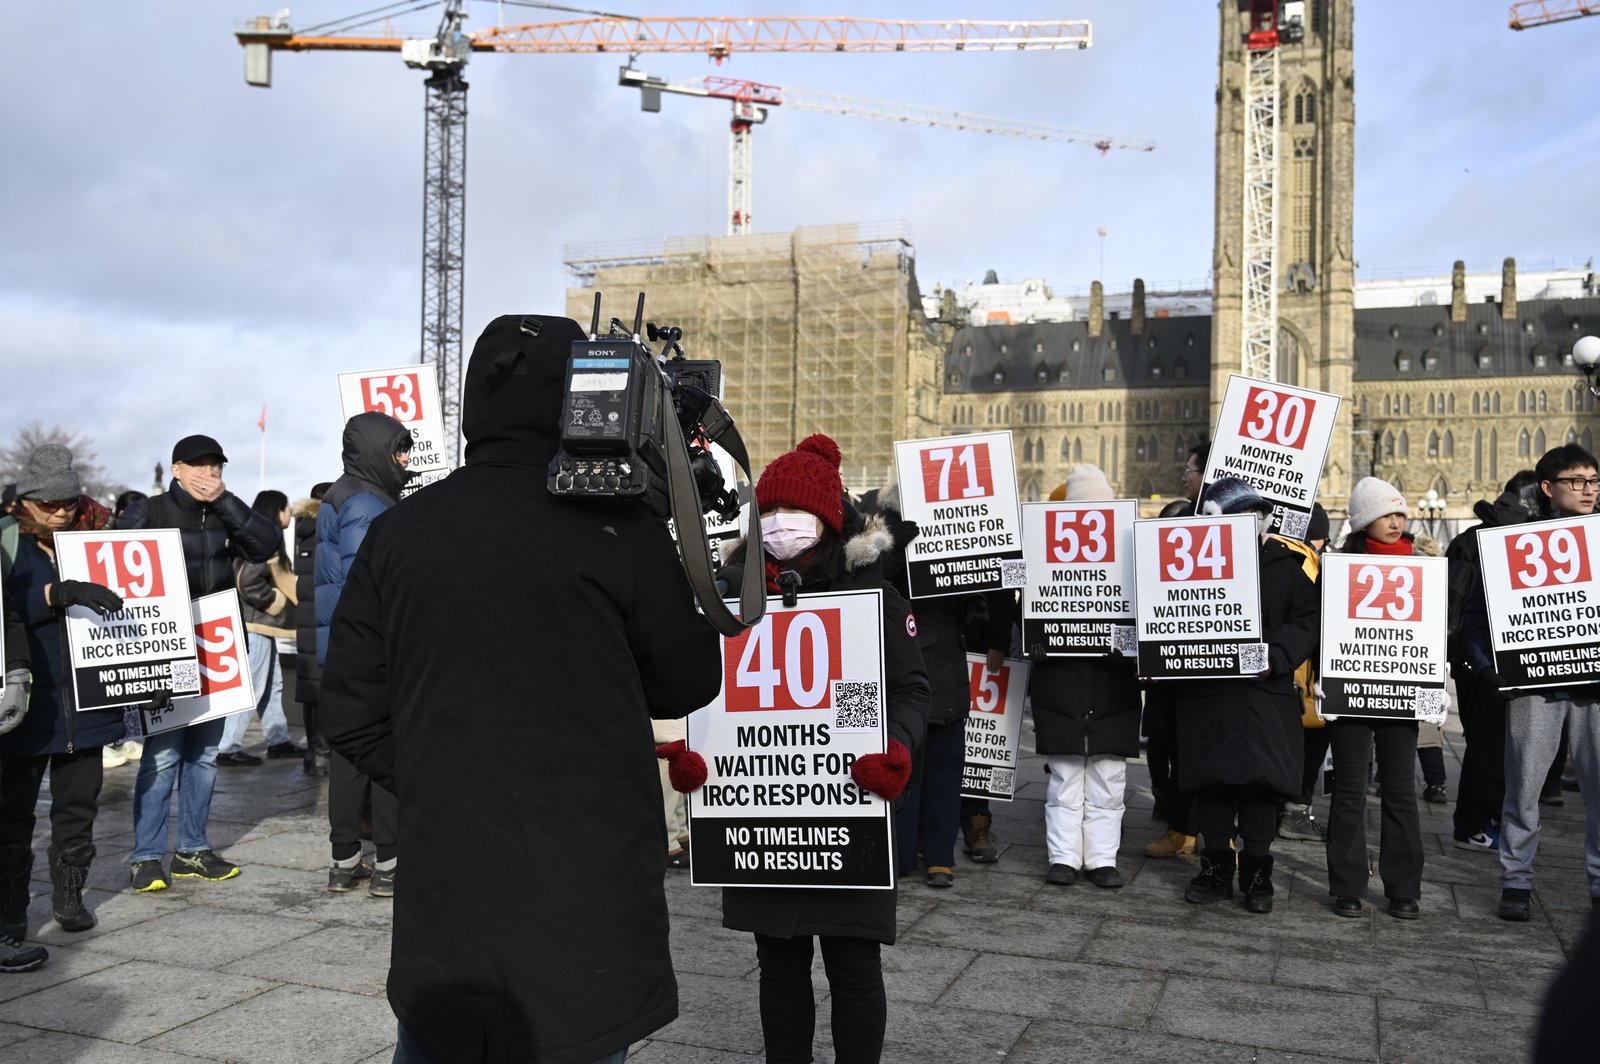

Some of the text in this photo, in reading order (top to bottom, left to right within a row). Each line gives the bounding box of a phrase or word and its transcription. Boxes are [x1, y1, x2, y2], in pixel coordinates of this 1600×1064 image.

[369, 374, 417, 422] 53
[1247, 390, 1306, 446] 30
[412, 440, 433, 452] FOR
[1240, 444, 1293, 466] MONTHS
[929, 445, 985, 500] 71
[1224, 455, 1303, 484] WAITING FOR
[933, 504, 989, 520] MONTHS
[921, 518, 1004, 537] WAITING FOR
[1053, 509, 1107, 562] 53
[915, 533, 1014, 554] IRCC RESPONSE
[1167, 525, 1226, 580] 34
[1515, 528, 1581, 587] 39
[96, 540, 153, 598] 19
[930, 557, 1002, 574] NO TIMELINES
[936, 570, 1000, 587] NO RESULTS
[1052, 569, 1107, 582] MONTHS
[1039, 584, 1122, 597] WAITING FOR
[1168, 587, 1226, 601] MONTHS
[1356, 565, 1414, 620] 23
[1522, 590, 1587, 608] MONTHS
[102, 605, 160, 621] MONTHS
[1031, 599, 1130, 613] IRCC RESPONSE
[1153, 603, 1242, 618] WAITING FOR
[1508, 609, 1572, 626] WAITING
[88, 621, 177, 640] WAITING FOR
[1044, 623, 1059, 634] NO
[1145, 619, 1252, 635] IRCC RESPONSE
[1355, 627, 1413, 641] MONTHS
[1501, 622, 1600, 643] IRCC RESPON
[82, 637, 187, 659] IRCC RESPONSE
[1049, 636, 1112, 647] NO RESULTS
[1160, 643, 1239, 656] NO TIMELINES
[1340, 643, 1428, 658] WAITING FOR
[1519, 652, 1537, 664] NO
[736, 612, 829, 708] 40
[1165, 657, 1234, 669] NO RESULTS
[1331, 659, 1436, 675] IRCC RESPONSE
[1527, 660, 1600, 677] NO RESULTS
[99, 664, 171, 683] NO TIMELINE
[106, 678, 172, 697] NO RESULTS
[1344, 683, 1417, 696] NO TIMELINE
[1349, 697, 1416, 710] NO RESULTS
[964, 717, 996, 731] NTHS
[737, 723, 830, 747] MONTHS
[985, 734, 1006, 746] FOR
[965, 746, 1011, 761] SPONSE
[714, 753, 857, 777] WAITING FOR
[961, 779, 990, 790] SULTS
[703, 783, 871, 806] IRCC RESPONSE
[726, 827, 850, 845] NO TIMELINES
[734, 852, 843, 870] NO RESULTS
